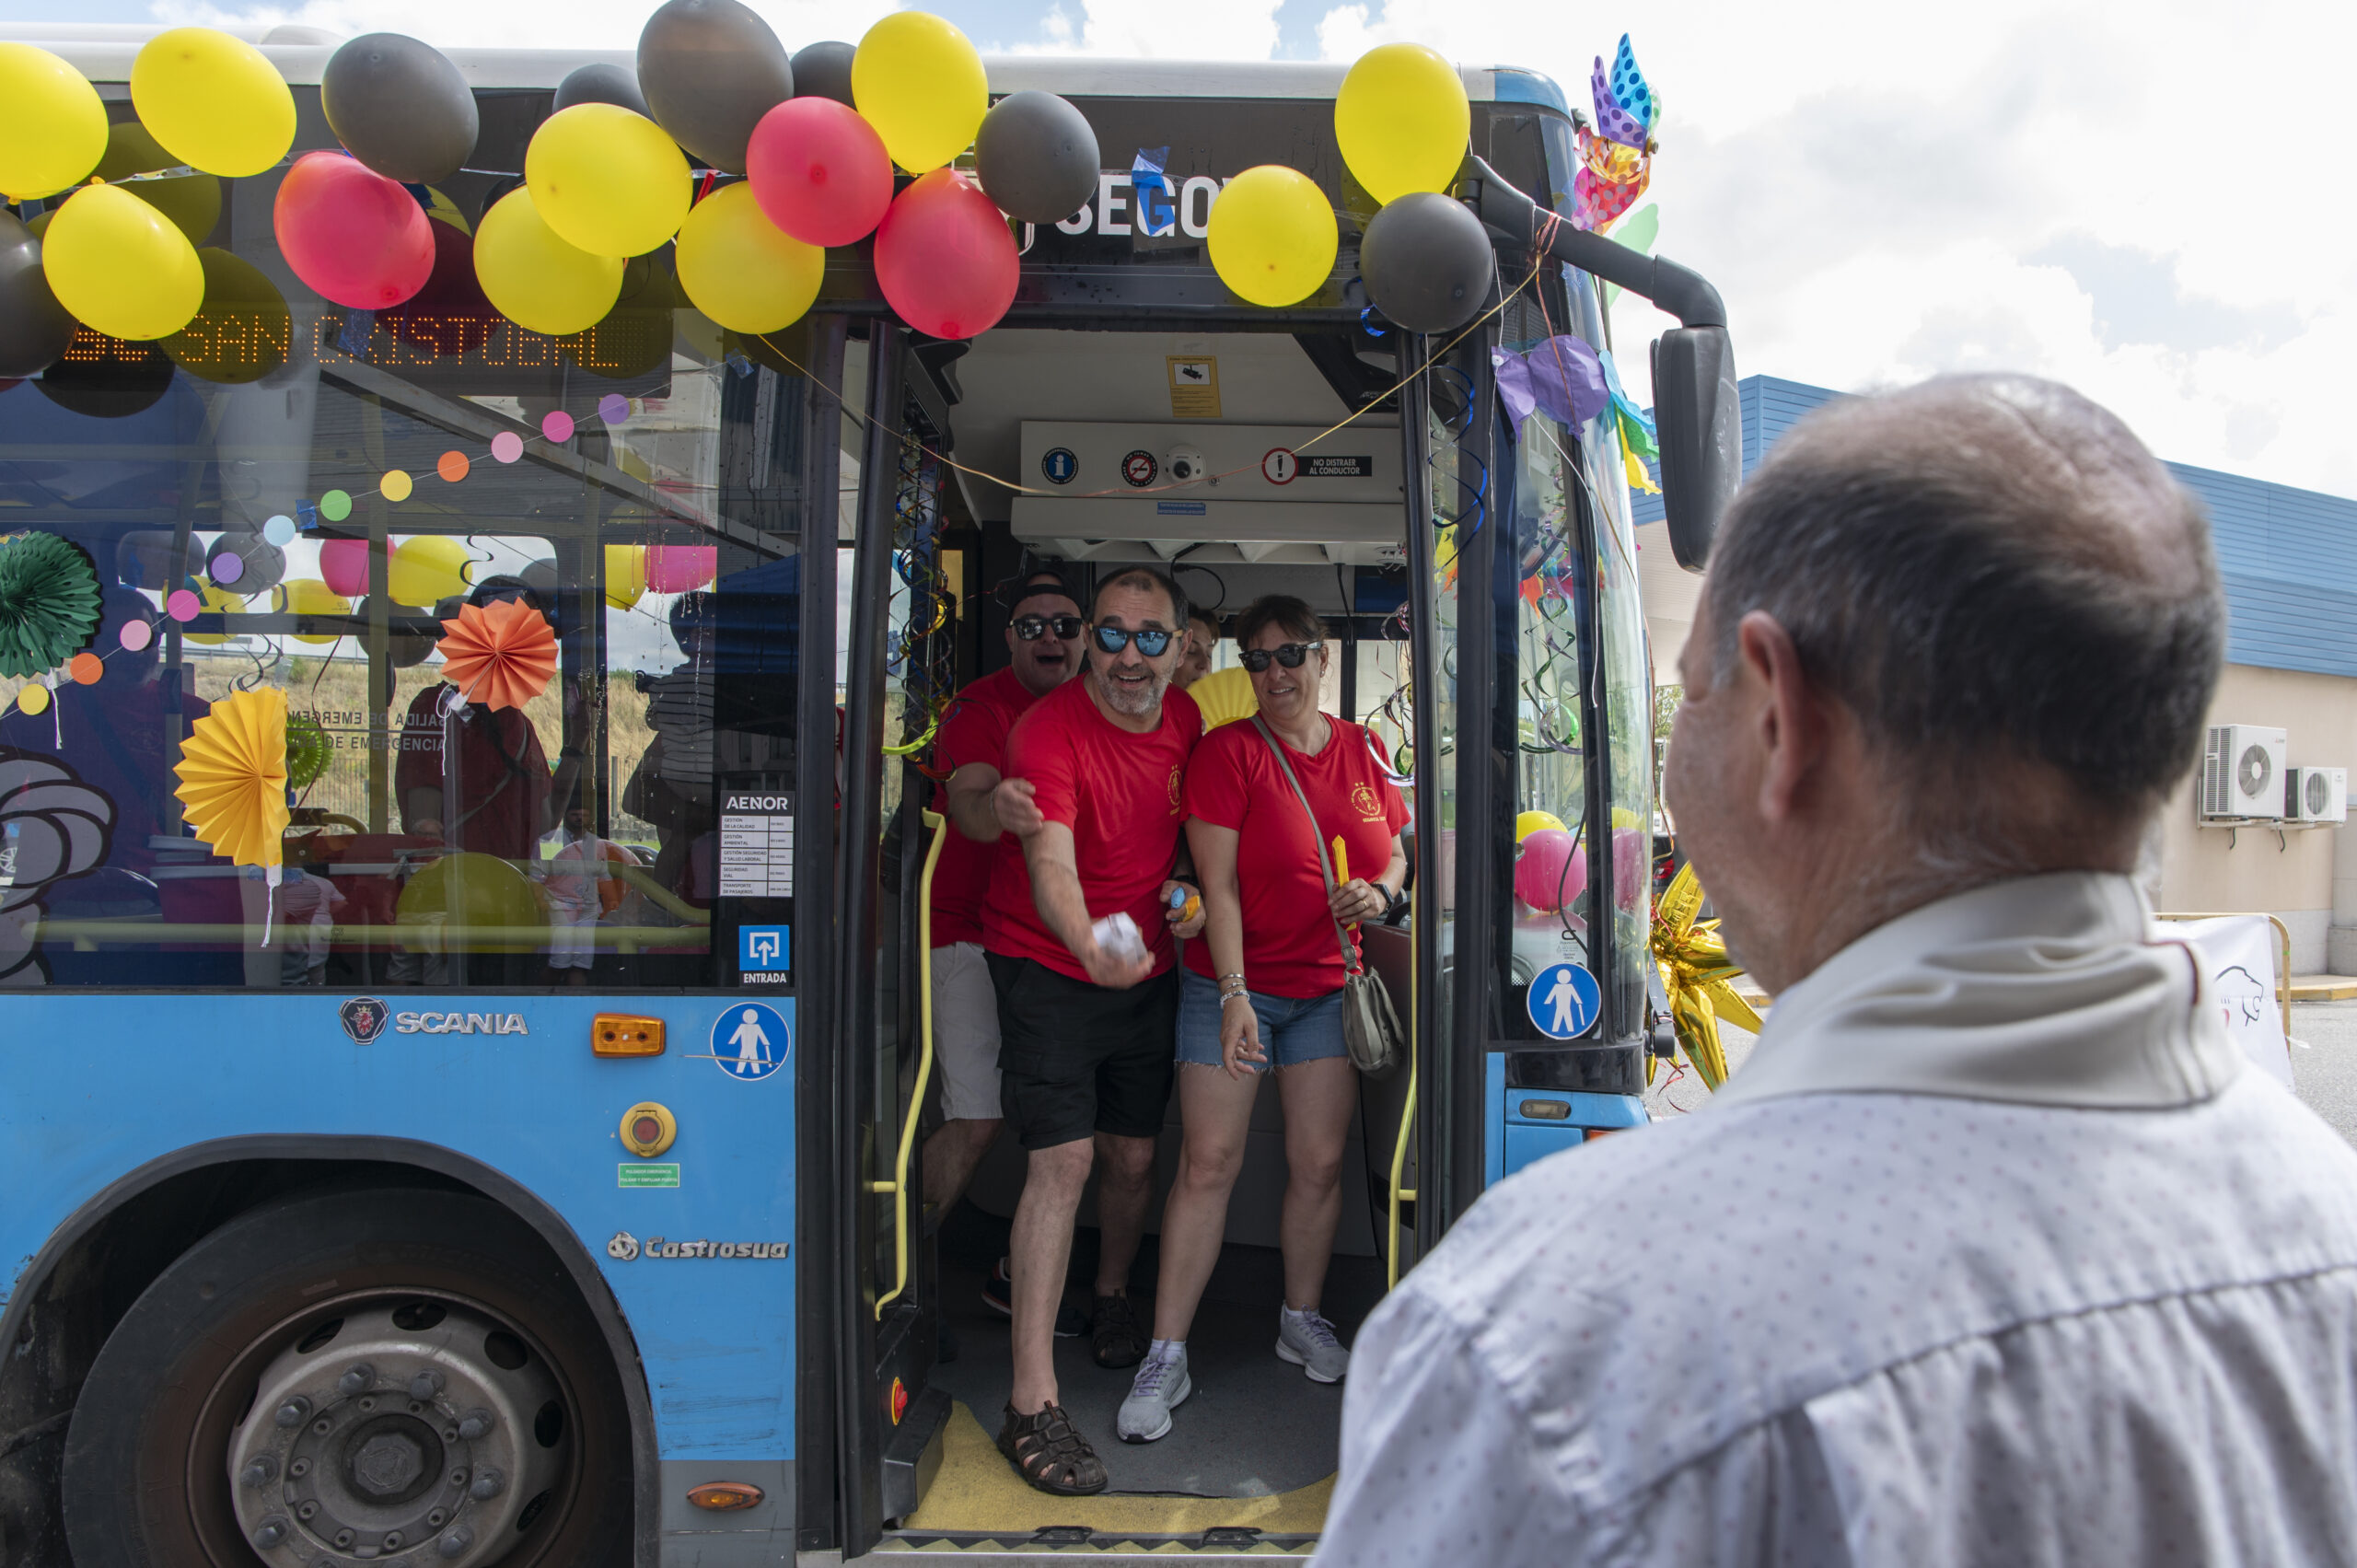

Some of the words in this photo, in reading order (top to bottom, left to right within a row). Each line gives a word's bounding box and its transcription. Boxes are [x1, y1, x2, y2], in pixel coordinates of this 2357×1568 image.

[1055, 174, 1235, 238] EGO
[181, 315, 290, 364] SAN
[1313, 459, 1324, 467] NO
[1326, 459, 1356, 467] DISTRAER
[1309, 467, 1318, 475] AL
[1318, 467, 1360, 475] CONDUCTOR
[324, 736, 343, 749] DE
[726, 796, 788, 810] AENOR
[743, 973, 787, 983] ENTRADA
[395, 1012, 529, 1035] SCANIA
[644, 1237, 789, 1260] Castrosua
